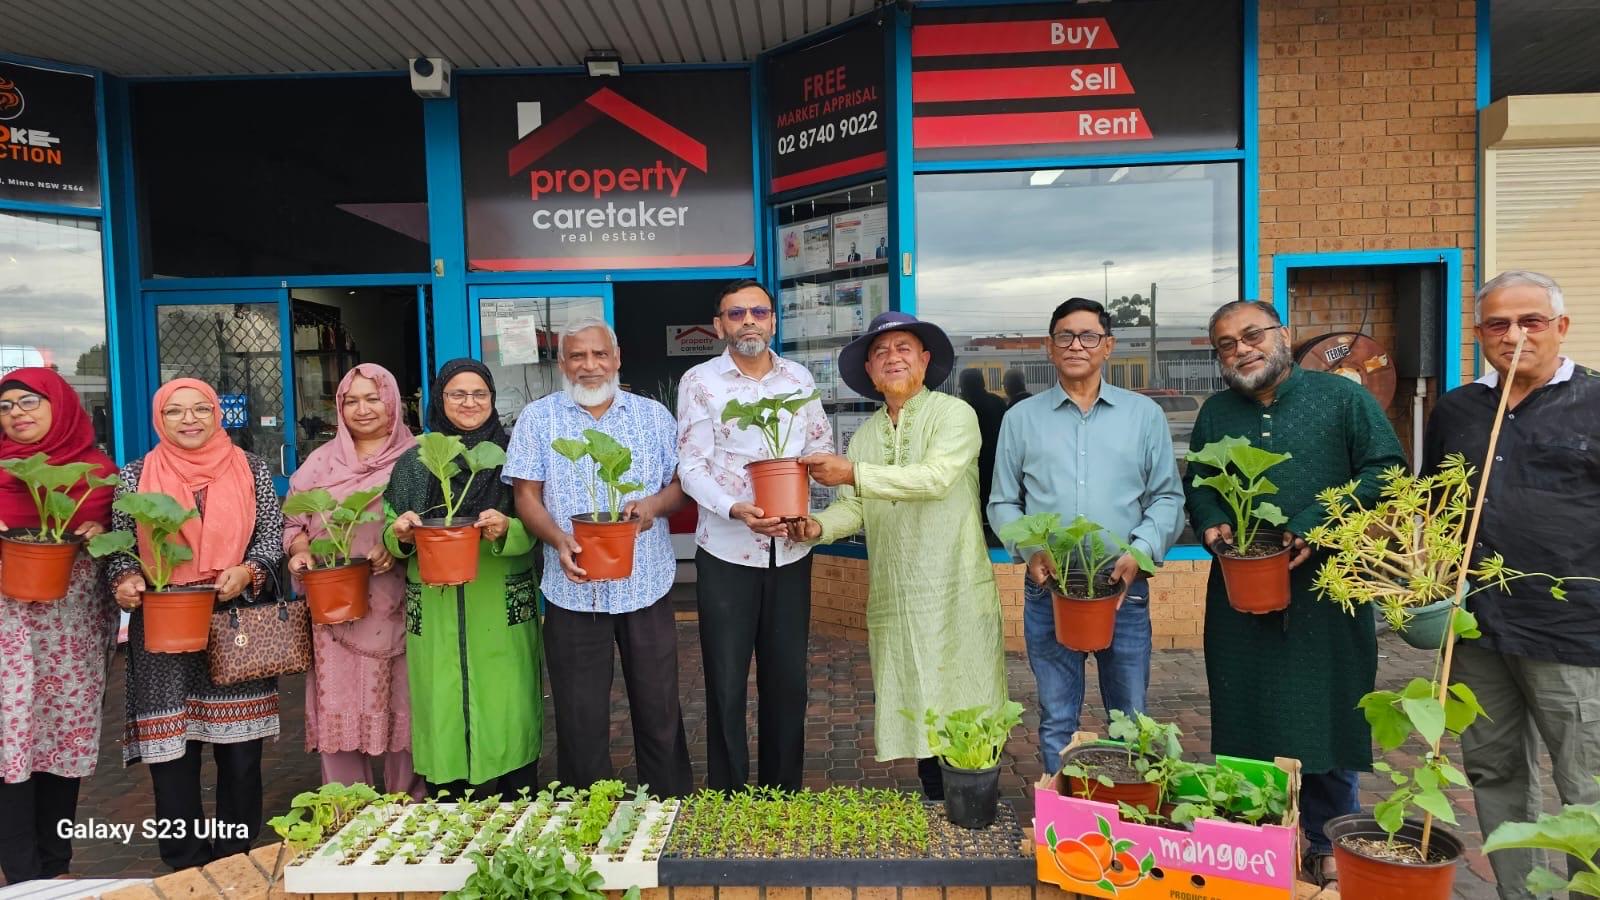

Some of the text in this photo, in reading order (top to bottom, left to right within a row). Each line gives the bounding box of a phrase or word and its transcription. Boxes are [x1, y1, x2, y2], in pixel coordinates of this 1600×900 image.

[1051, 22, 1099, 49] Buy
[803, 66, 847, 101] FREE
[1070, 67, 1116, 91] Sell
[776, 85, 878, 128] MARKET APPRISAL
[777, 110, 878, 155] 02 8740 9022
[1078, 111, 1138, 136] Rent
[8, 178, 35, 187] Minto
[37, 181, 60, 190] NSW
[62, 184, 84, 192] 2566
[529, 160, 688, 201] property
[532, 201, 689, 230] caretaker
[561, 230, 656, 243] real estate
[1159, 836, 1277, 878] mangoes
